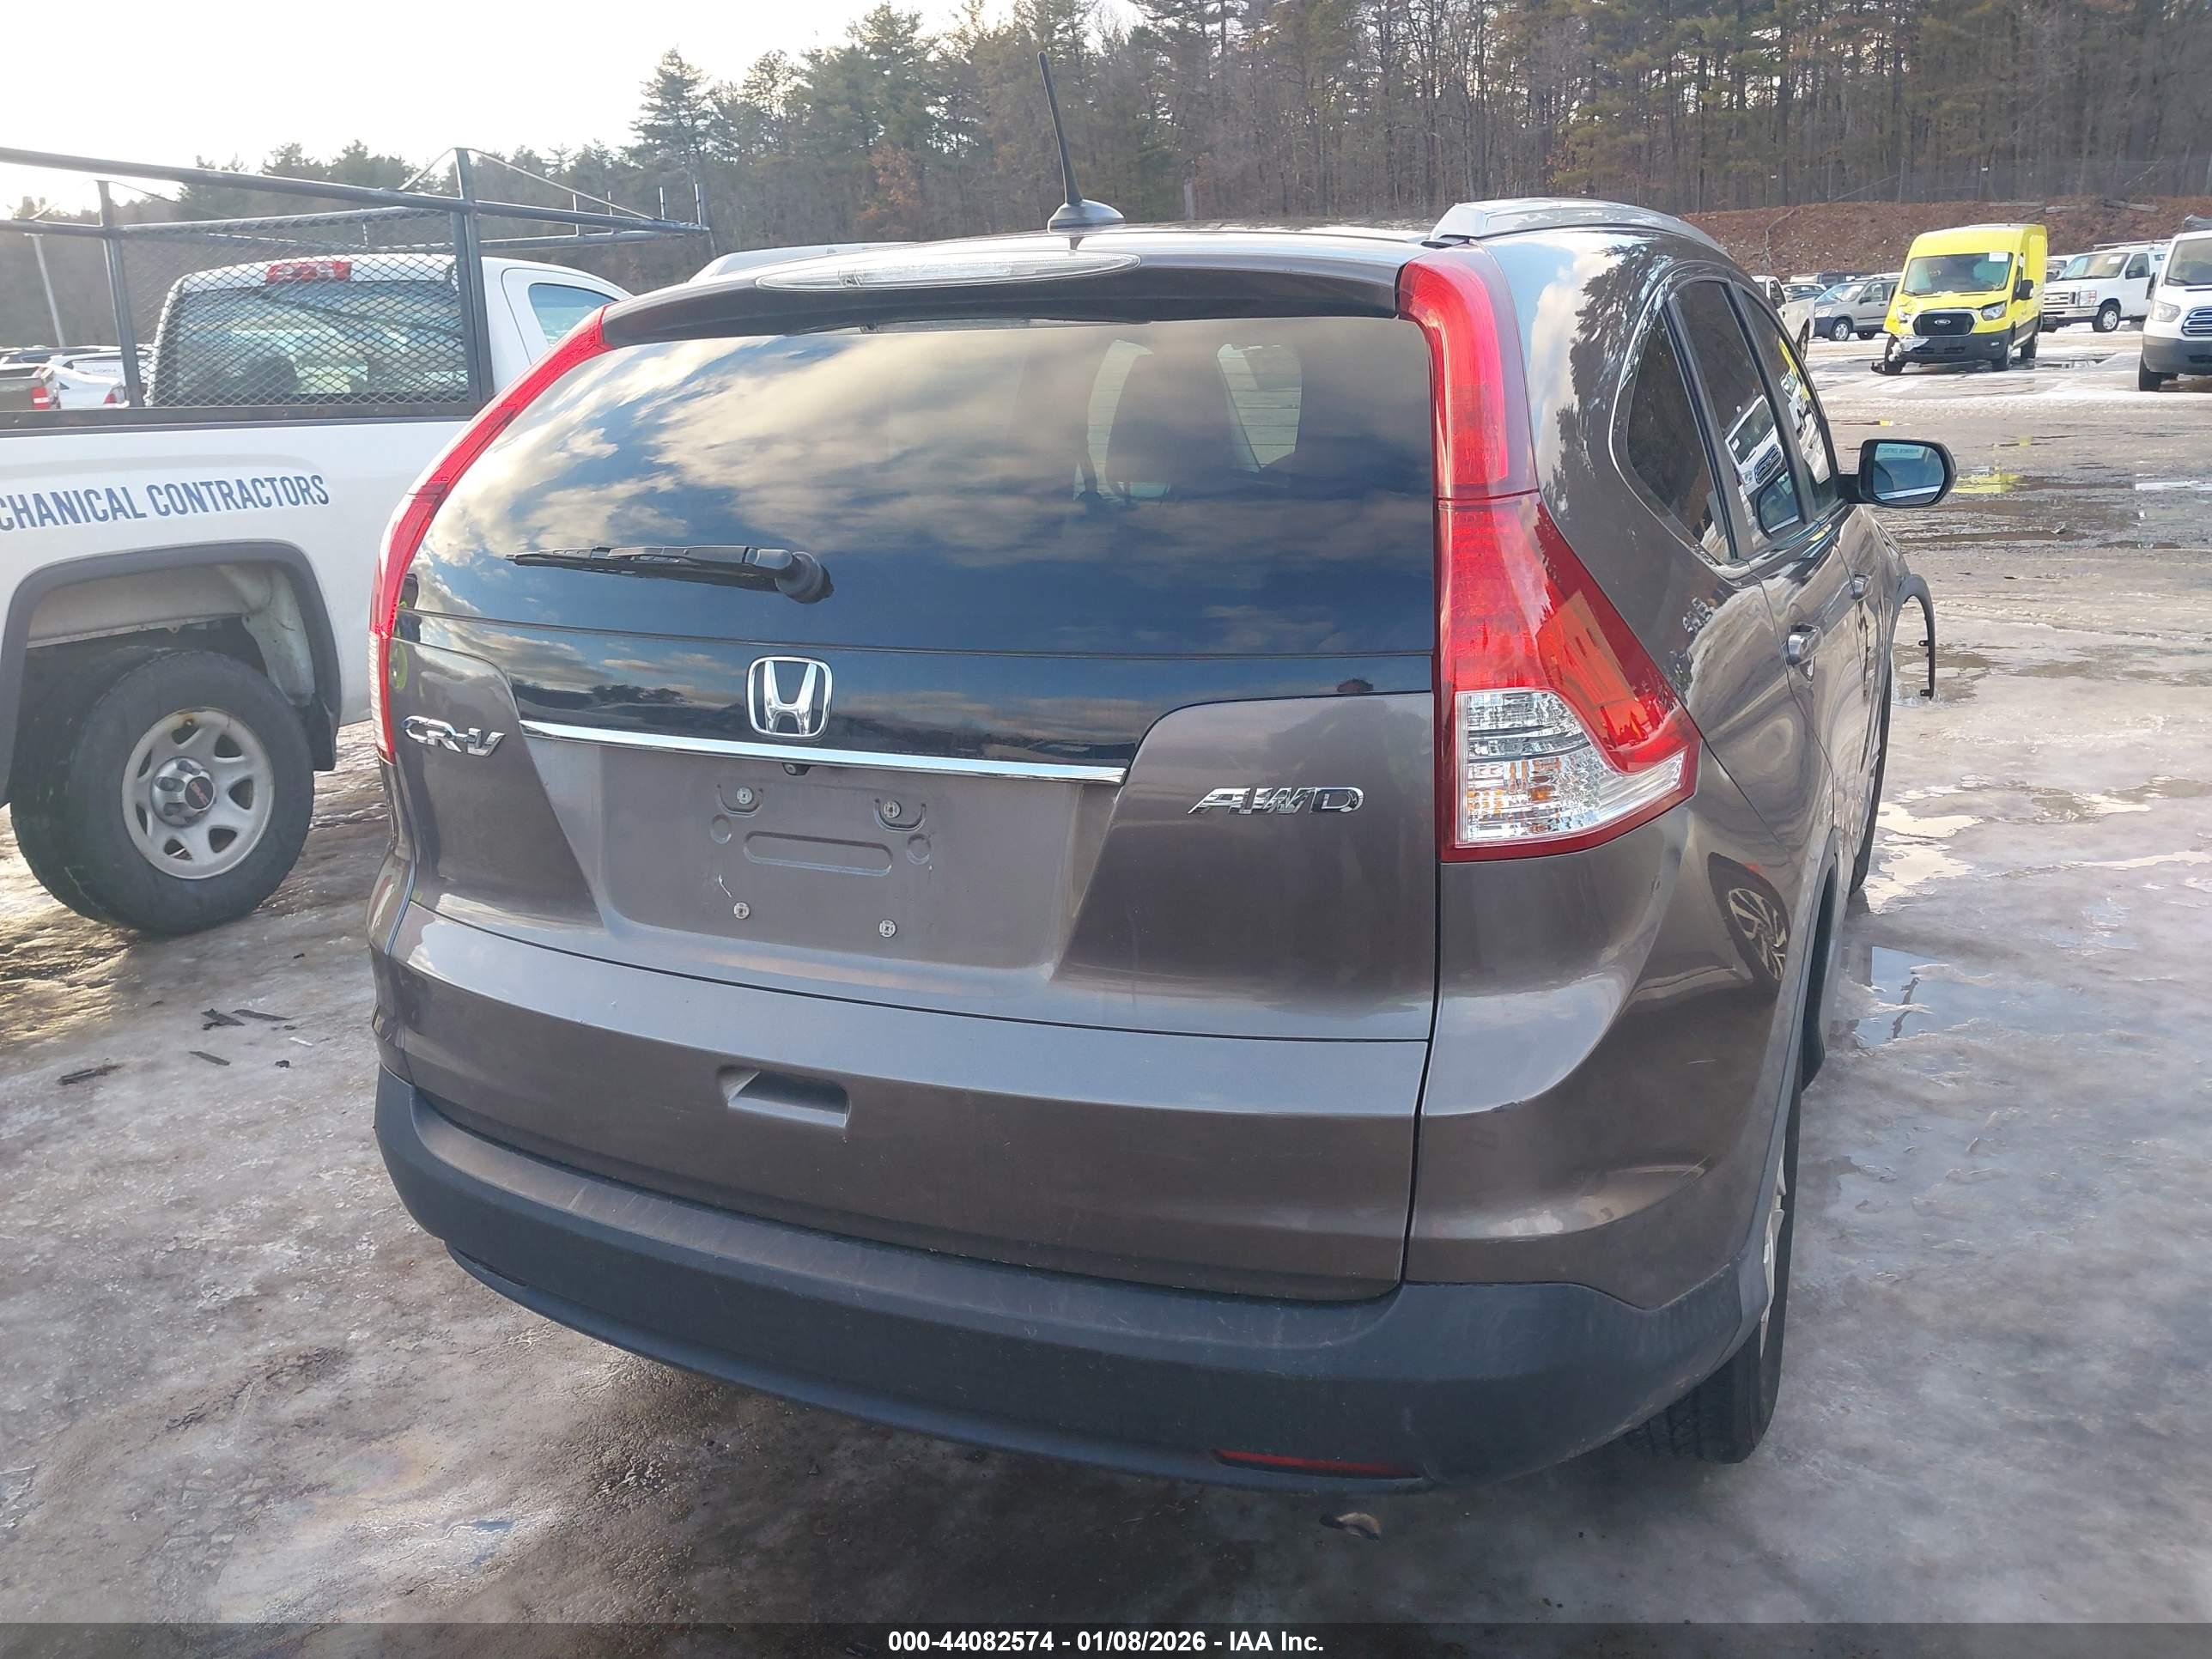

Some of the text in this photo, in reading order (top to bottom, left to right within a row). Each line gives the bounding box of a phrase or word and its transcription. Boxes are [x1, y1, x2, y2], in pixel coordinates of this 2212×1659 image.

[146, 474, 330, 517] CONTRACTORS
[401, 714, 506, 757] CR-V
[1188, 787, 1364, 814] AWD
